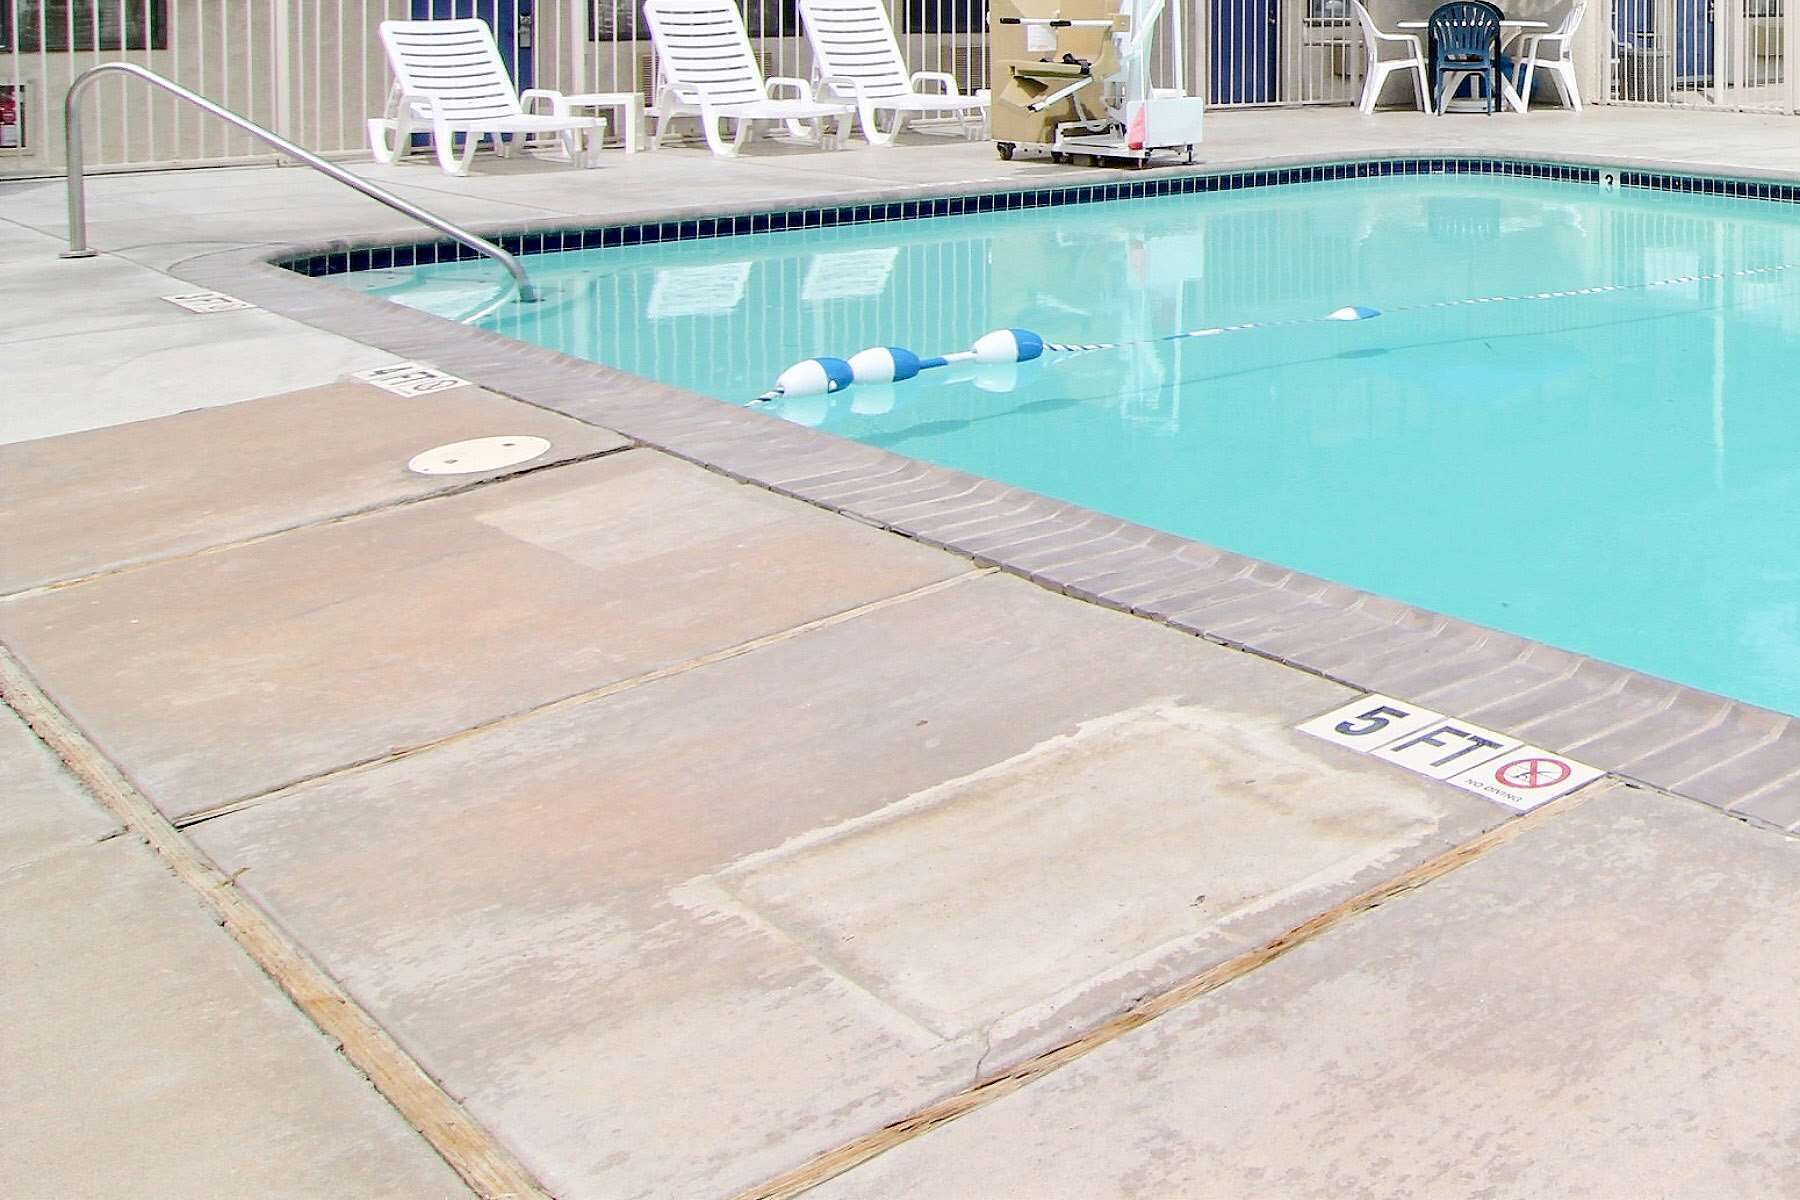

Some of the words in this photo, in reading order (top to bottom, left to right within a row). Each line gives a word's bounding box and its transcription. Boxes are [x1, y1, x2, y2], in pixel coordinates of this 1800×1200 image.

[1334, 705, 1410, 736] 5
[1391, 725, 1505, 768] FT
[1464, 778, 1484, 788] NO
[1483, 785, 1523, 802] DIVING
